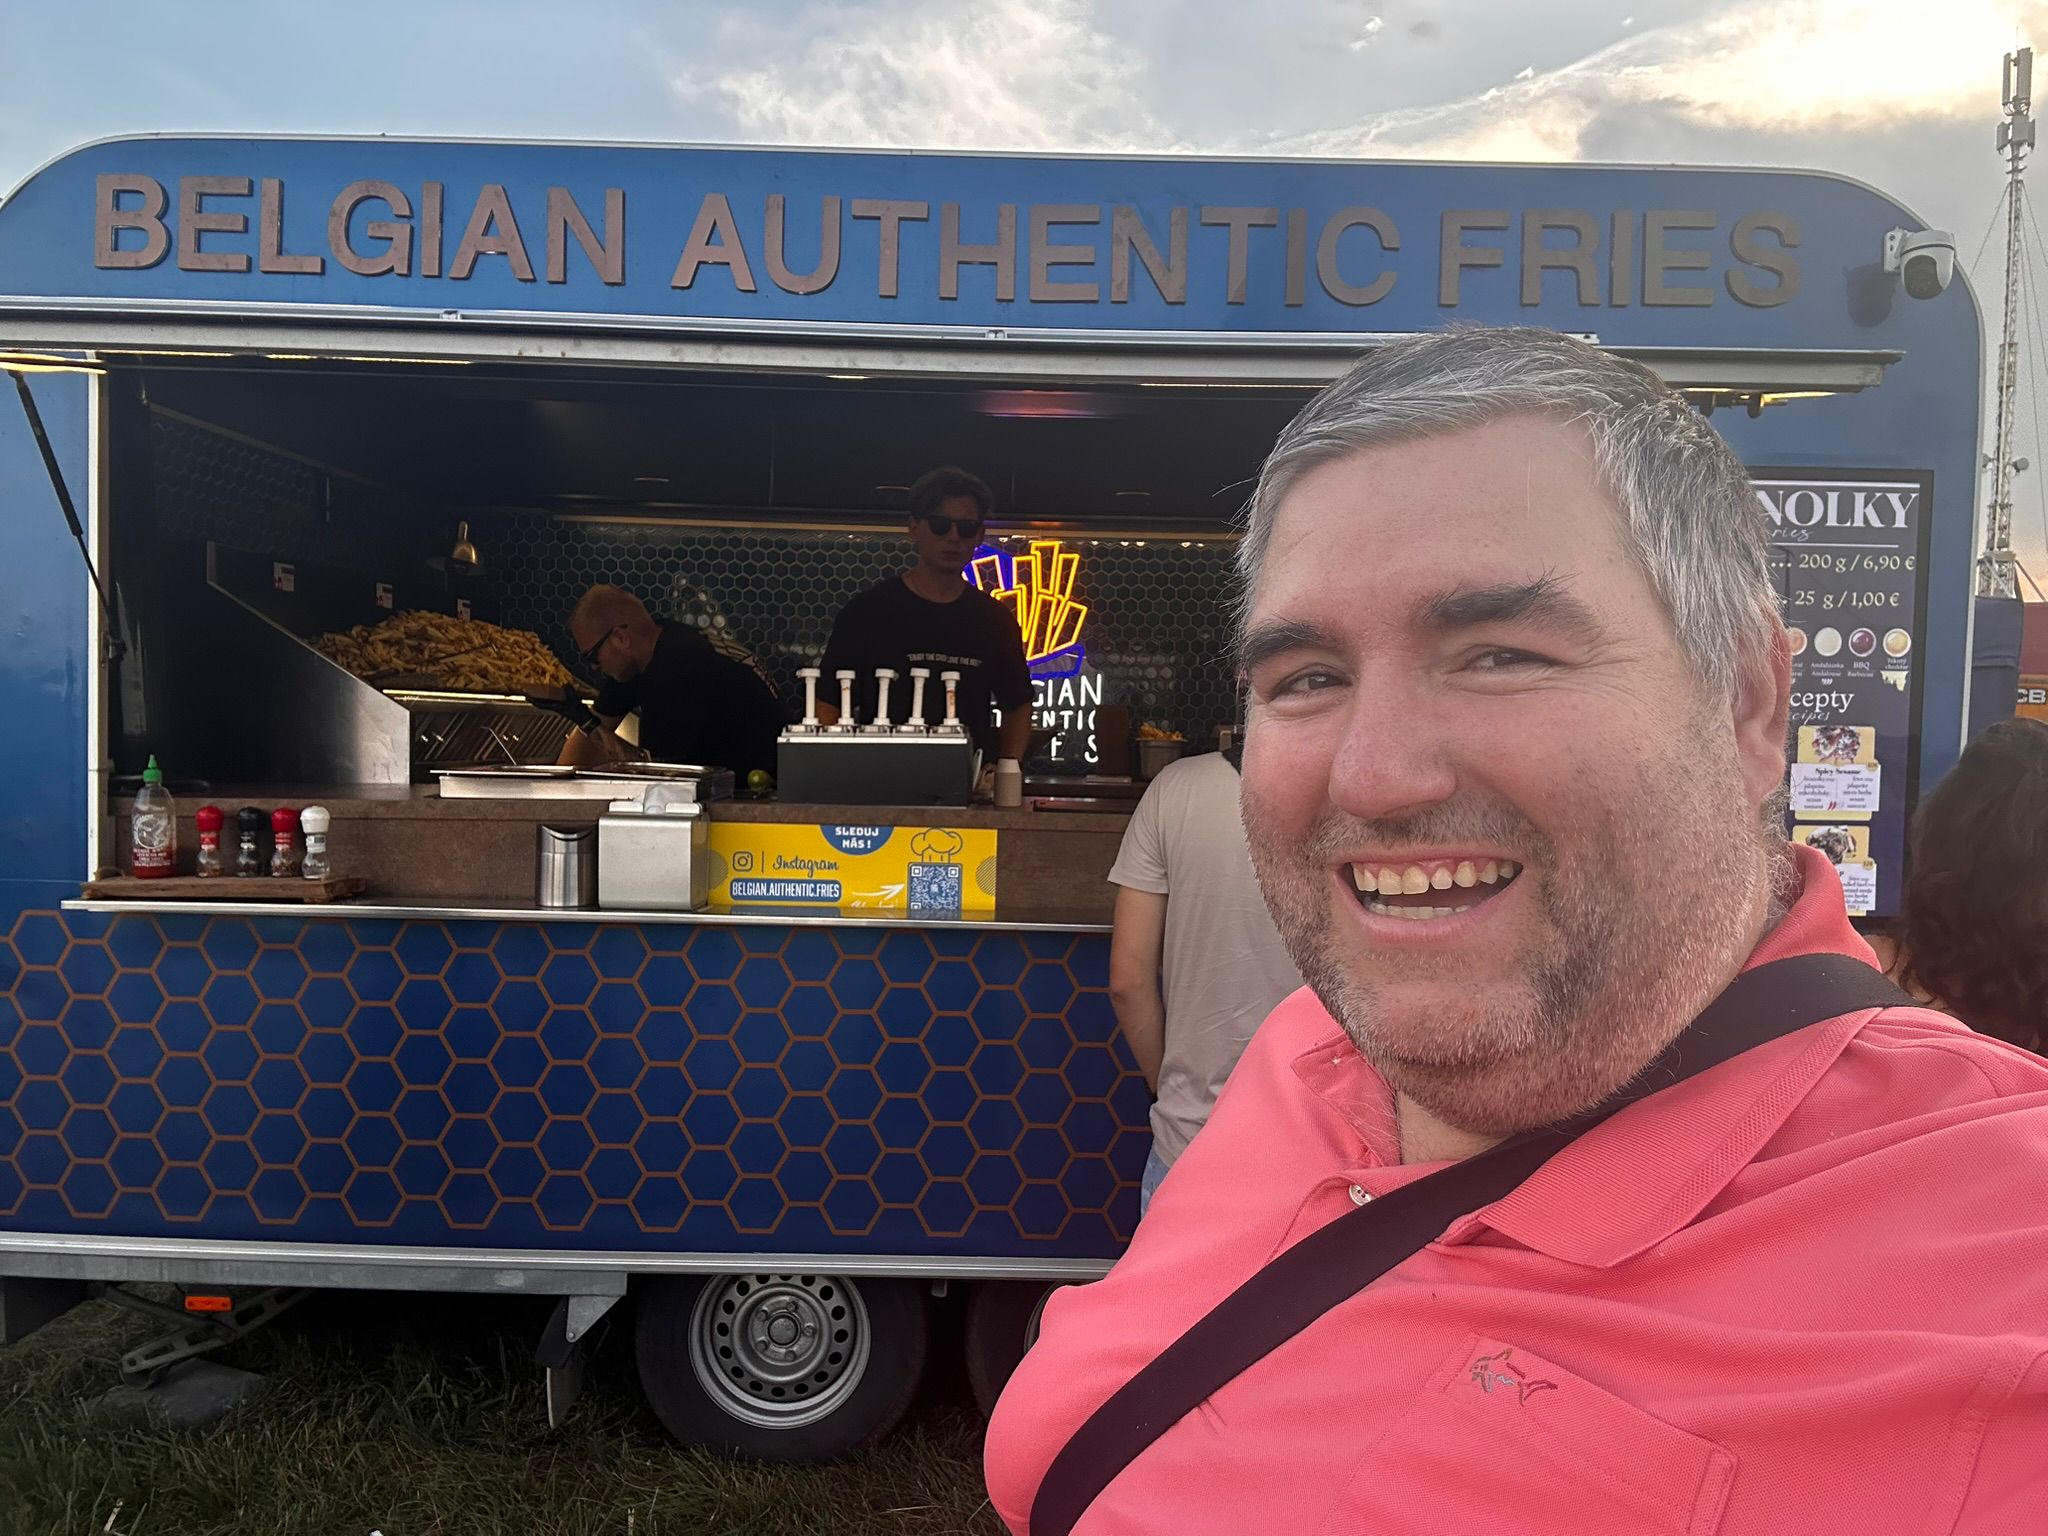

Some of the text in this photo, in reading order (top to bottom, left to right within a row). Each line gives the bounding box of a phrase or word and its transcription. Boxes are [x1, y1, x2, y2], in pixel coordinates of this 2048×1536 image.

[95, 174, 1801, 308] BELGIAN AUTHENTIC FRIES
[1756, 490, 1919, 528] NOLKY
[1772, 528, 1813, 542] ries
[1799, 554, 1832, 569] 200
[1835, 557, 1847, 573] g
[1863, 555, 1901, 572] 6,90
[1905, 556, 1915, 570] €
[1795, 590, 1816, 605] 25
[1823, 593, 1834, 609] g
[1851, 592, 1885, 608] 1,00
[1890, 592, 1900, 607] €
[1853, 661, 1870, 671] BBQ
[1031, 673, 1103, 707] GIAN
[1790, 690, 1855, 713] cepty
[1792, 710, 1830, 725] cipes
[772, 855, 840, 878] Instagram
[732, 881, 840, 898] BELGIAN.AUTHENTIC.FRIES
